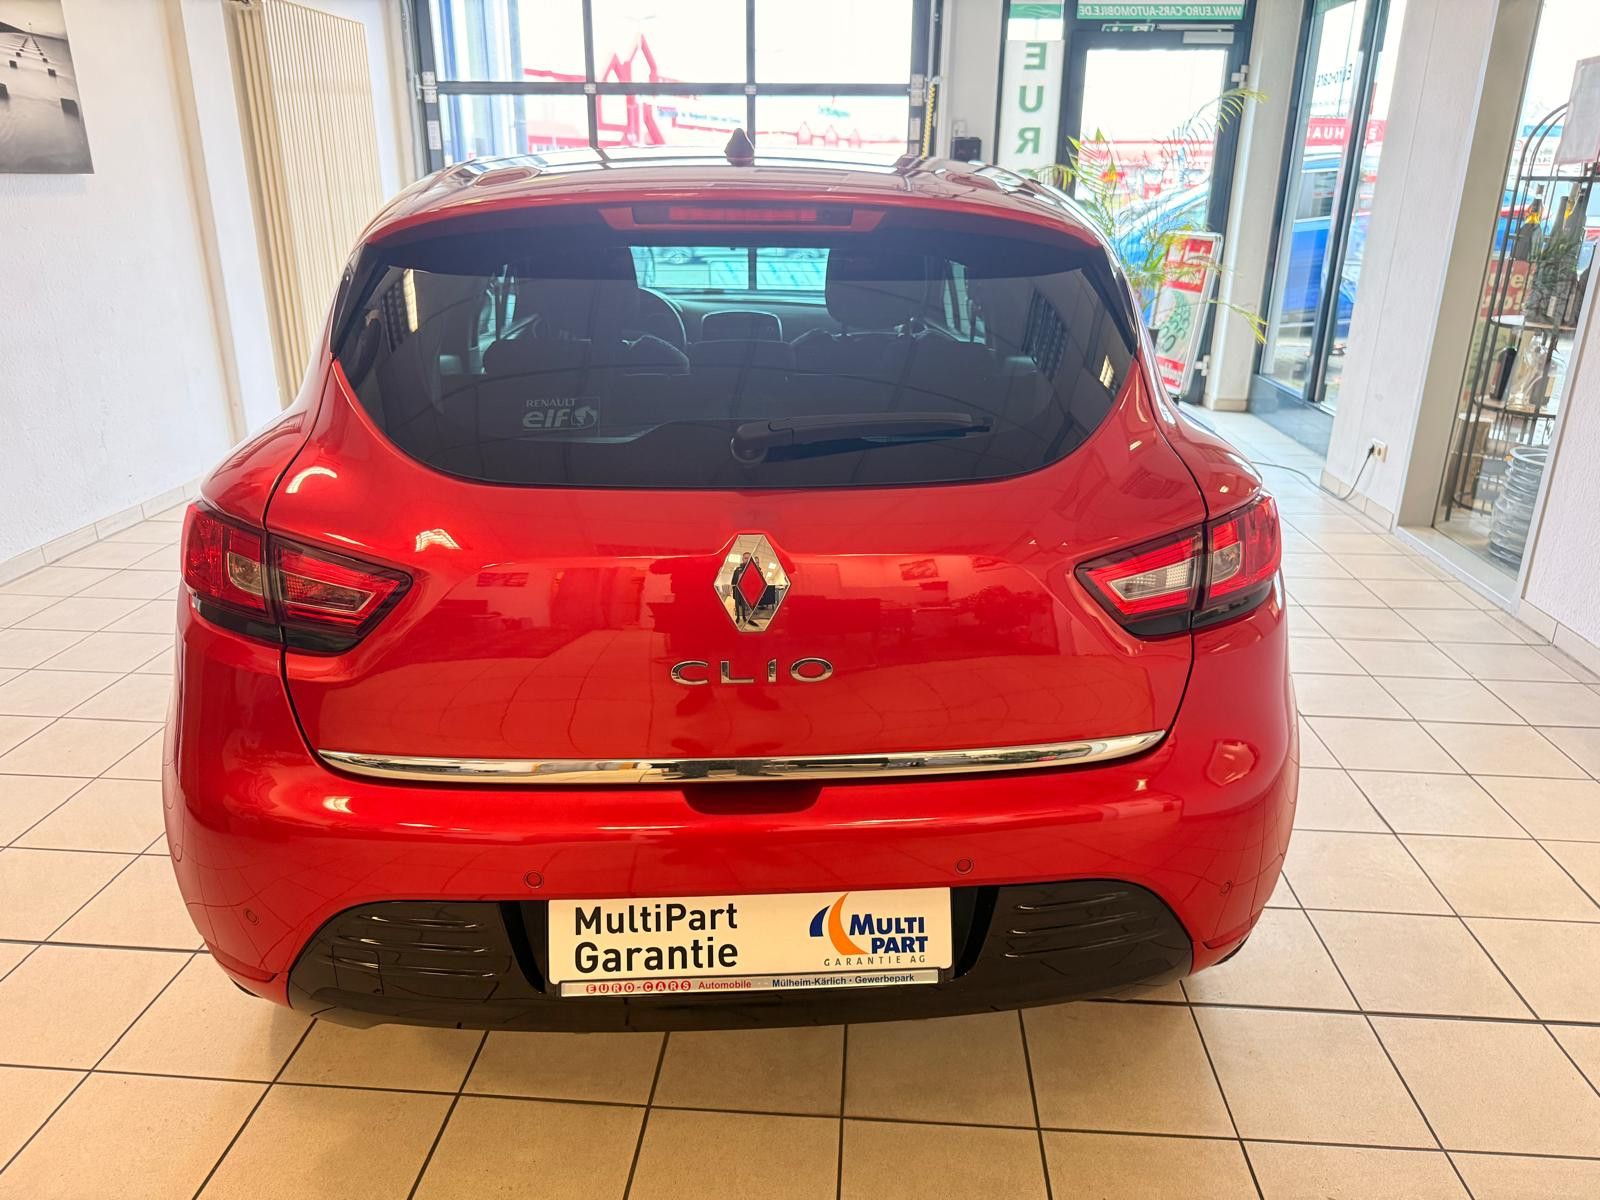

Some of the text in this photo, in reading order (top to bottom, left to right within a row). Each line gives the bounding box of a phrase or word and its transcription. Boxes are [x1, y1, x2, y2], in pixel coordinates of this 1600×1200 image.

[526, 398, 577, 408] RENAULT
[522, 409, 571, 428] elf
[670, 657, 834, 686] CLIO
[574, 903, 738, 936] MultiPart
[849, 913, 925, 936] MULTI
[574, 937, 738, 973] Garantie
[871, 936, 928, 954] PART
[823, 954, 926, 967] GARANTIE AG
[586, 973, 915, 994] EURO-CARS Automobile Mülheim-Kärlich Gewerbepark
